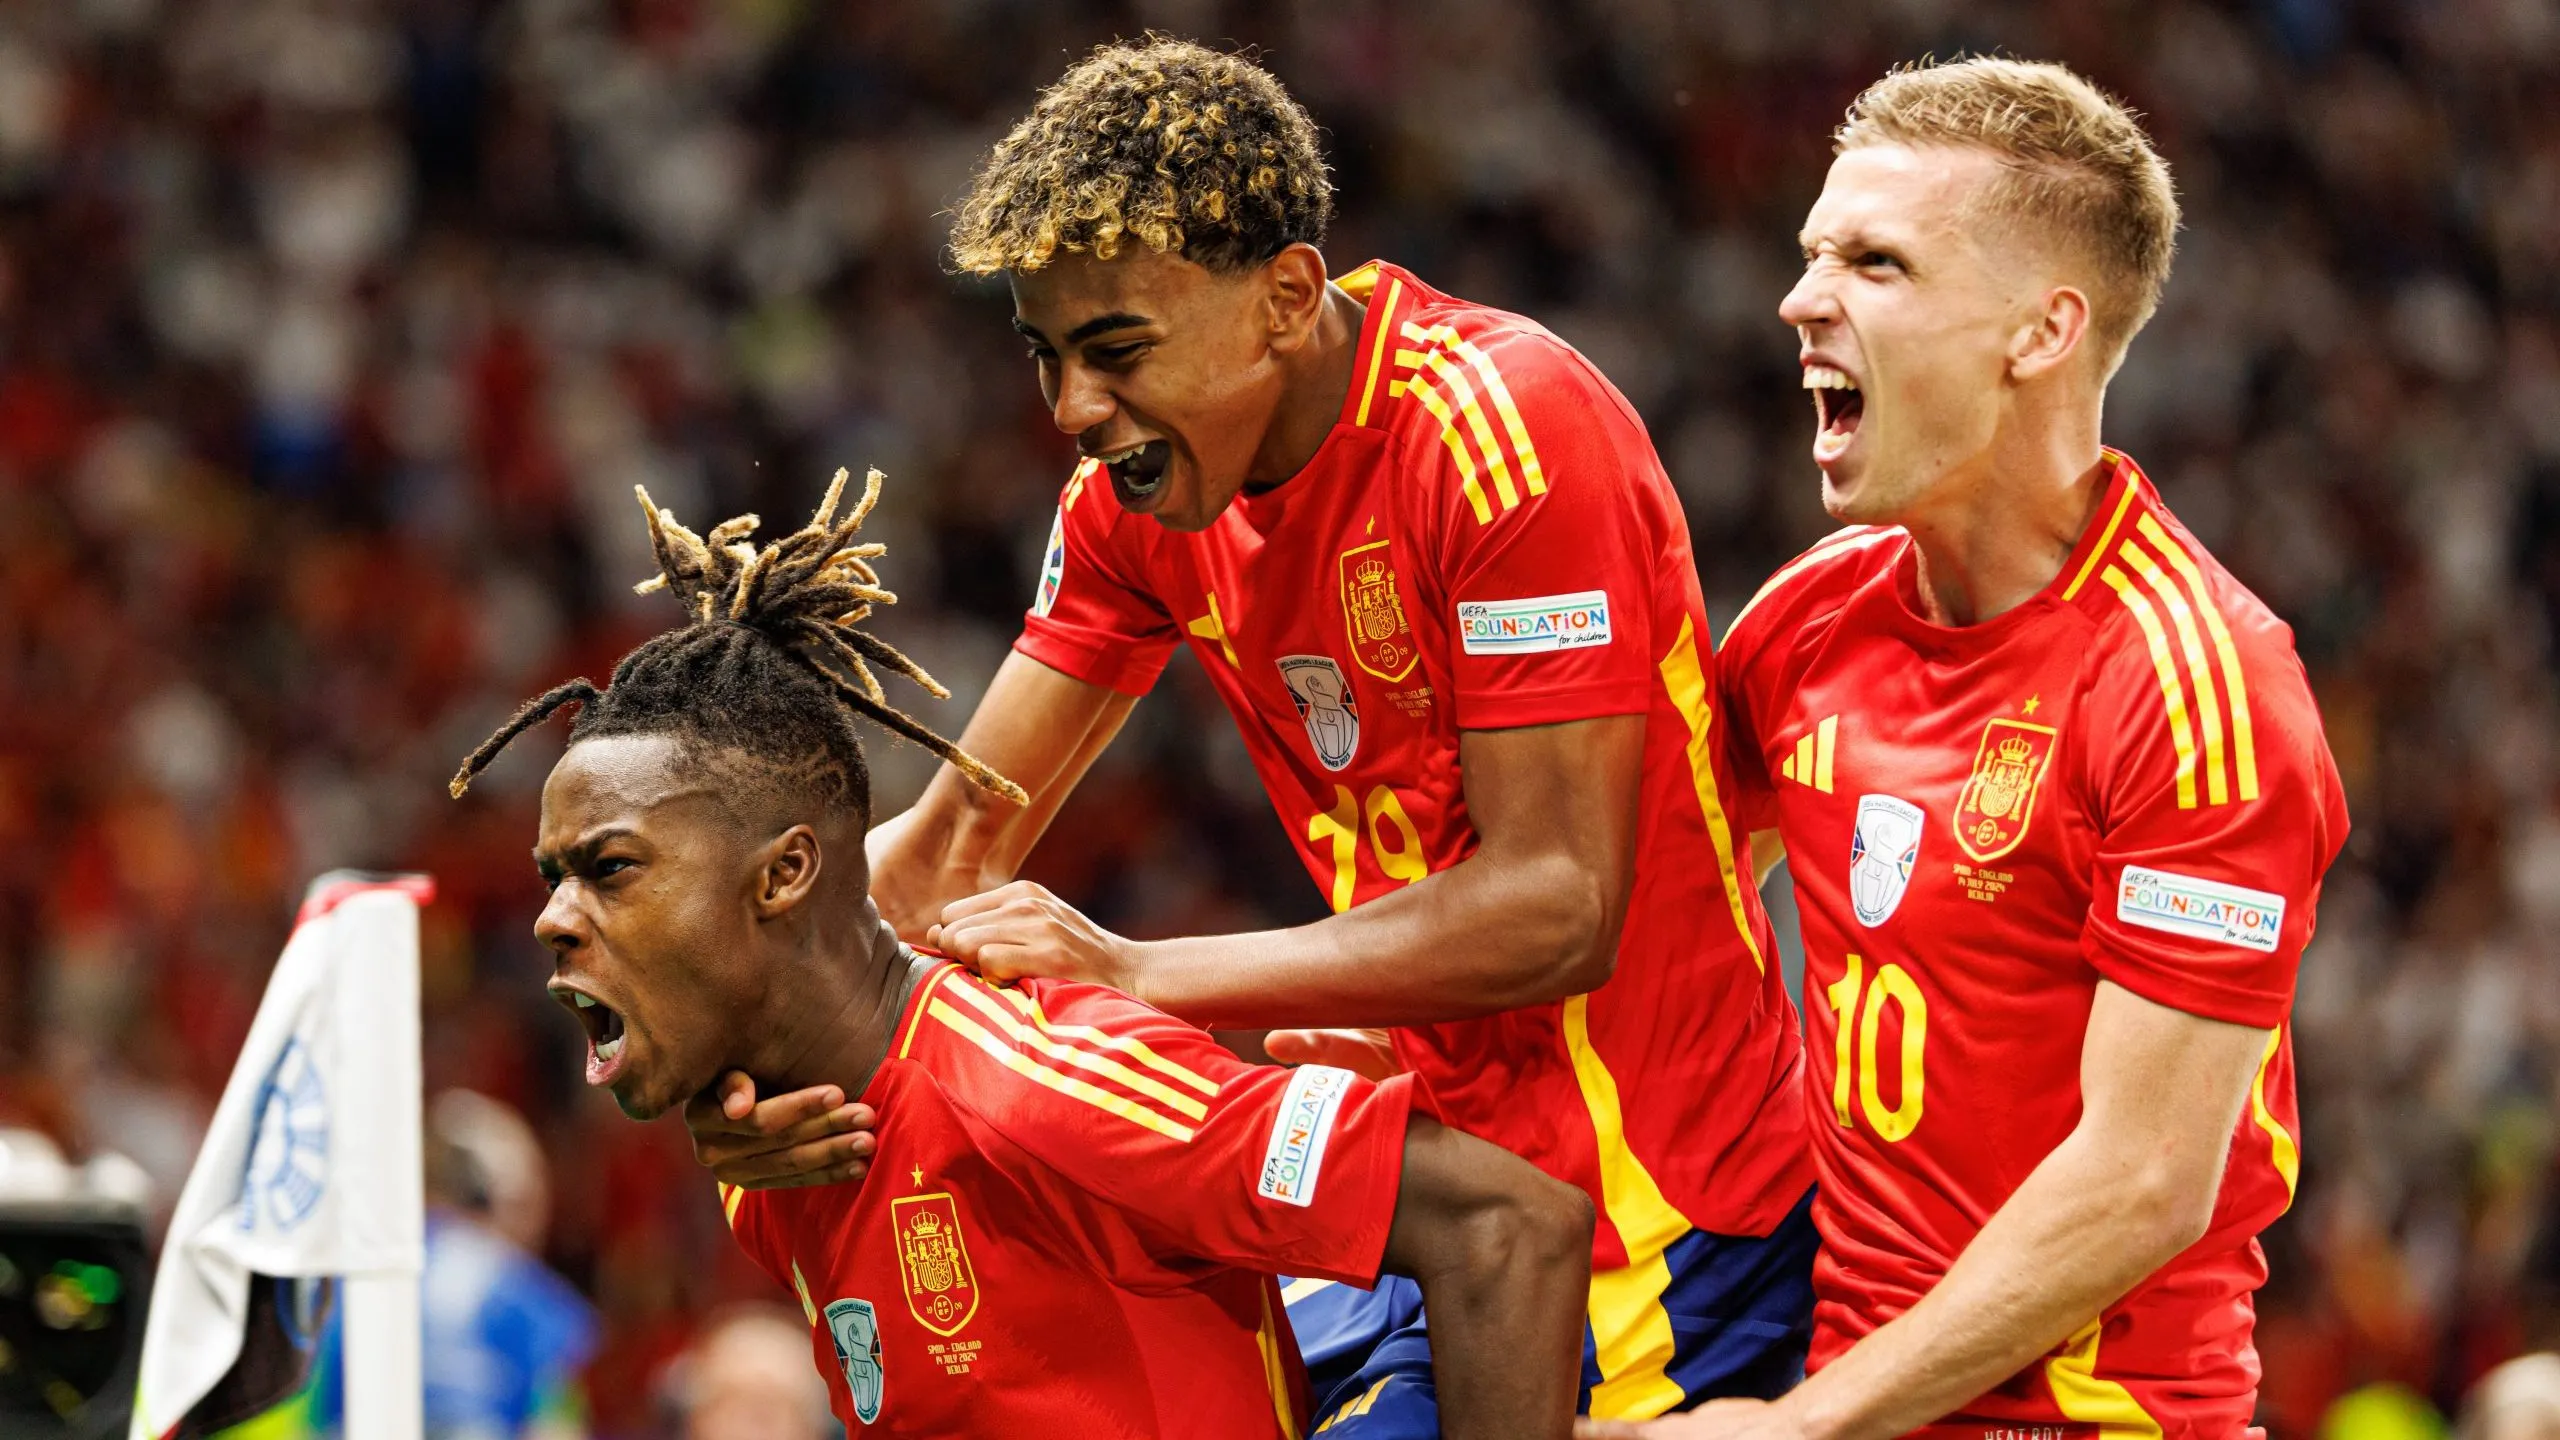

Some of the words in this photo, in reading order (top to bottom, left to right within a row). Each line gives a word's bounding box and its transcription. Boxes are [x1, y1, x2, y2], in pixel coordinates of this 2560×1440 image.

[1461, 605, 1487, 617] UEFA
[1558, 634, 1571, 648] for
[1574, 632, 1608, 643] children
[1308, 784, 1428, 914] 19
[1978, 869, 2014, 883] ENGLAND
[2125, 871, 2159, 887] UEFA
[2224, 928, 2236, 941] for
[2240, 932, 2273, 947] children
[1827, 953, 1928, 1143] 10
[1262, 1156, 1281, 1193] UEFA
[927, 1344, 945, 1355] SPAIN
[951, 1340, 982, 1352] ENGLAND
[943, 1354, 957, 1364] JULY
[959, 1352, 977, 1363] 2024
[946, 1364, 970, 1375] BERLIN
